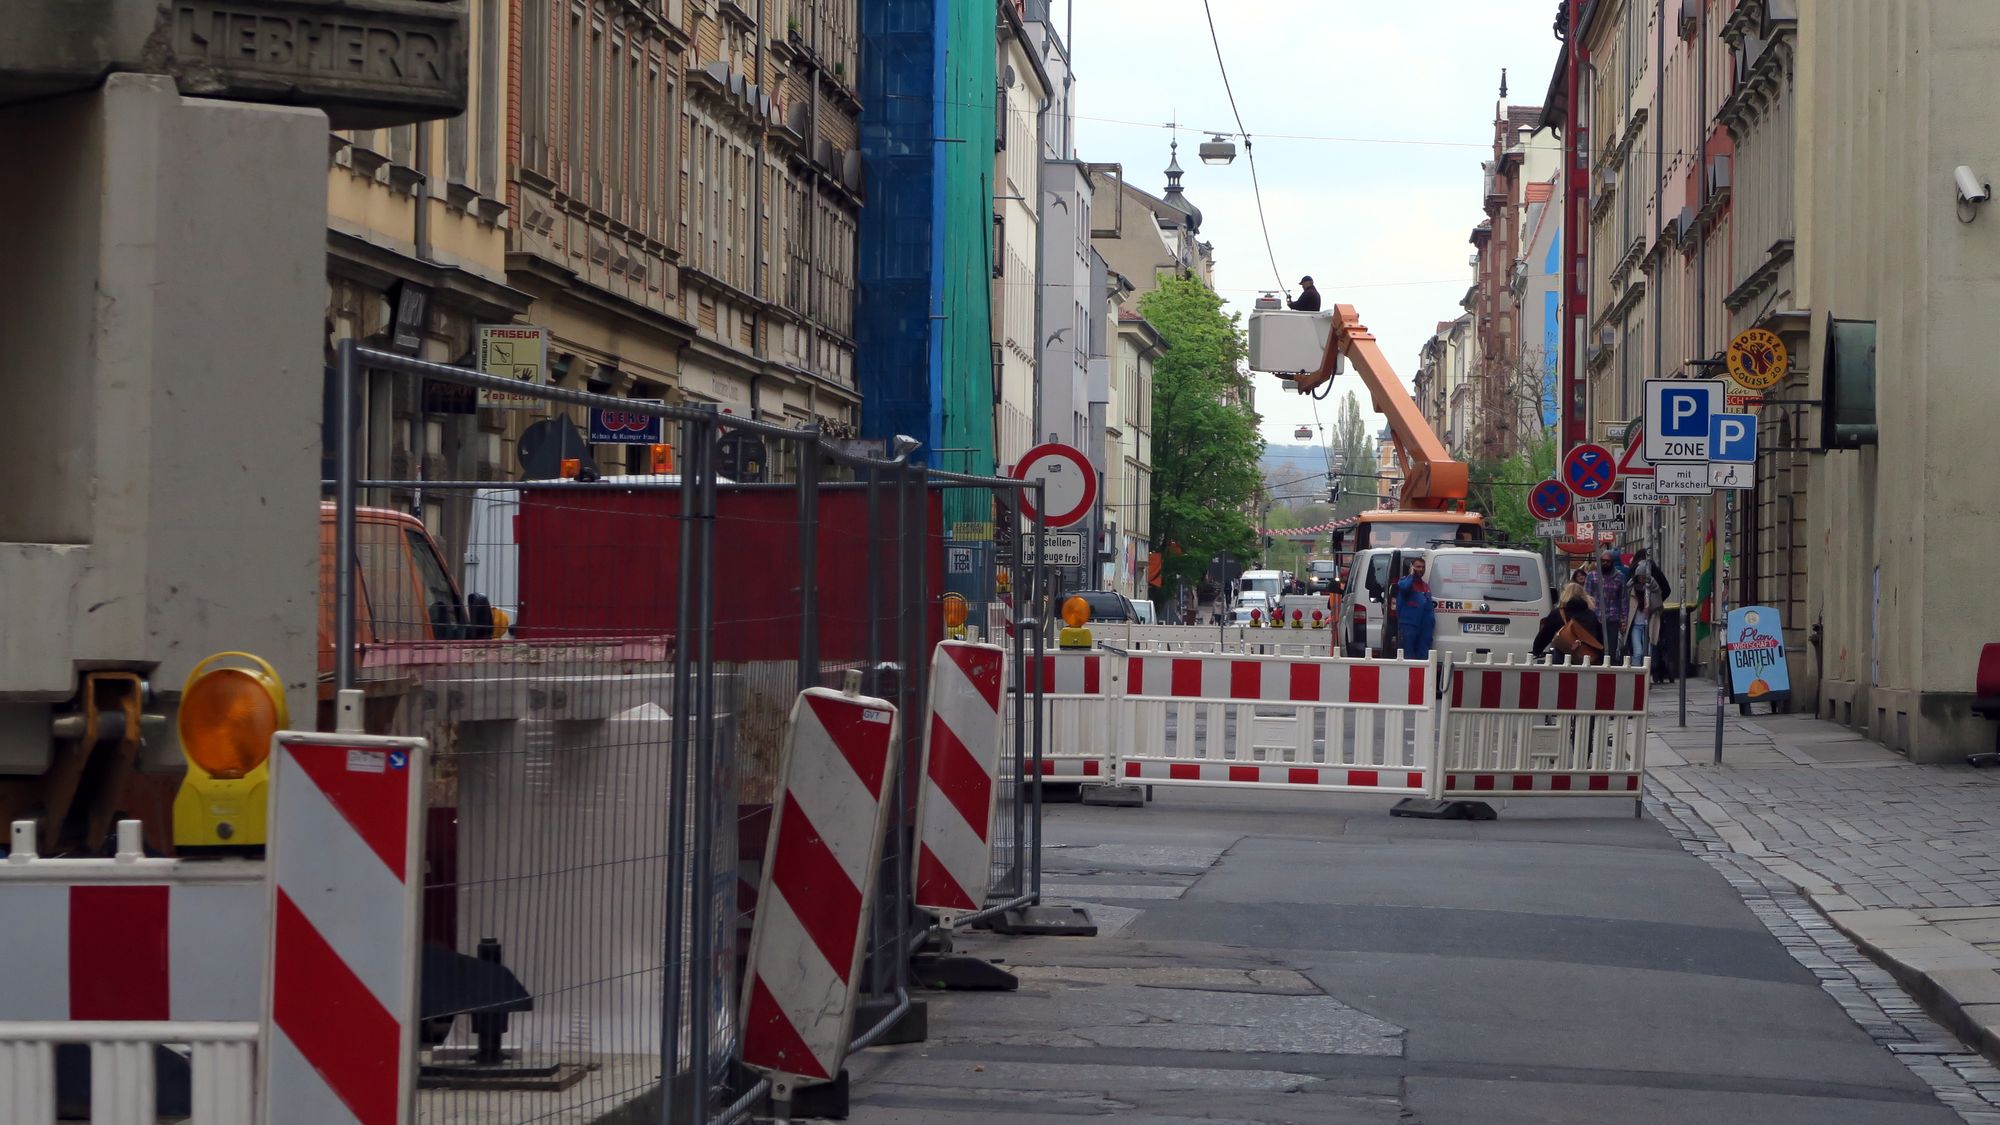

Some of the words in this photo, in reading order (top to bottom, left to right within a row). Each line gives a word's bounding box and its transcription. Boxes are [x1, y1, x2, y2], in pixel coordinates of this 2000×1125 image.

[176, 7, 440, 82] LIEBHERR
[490, 329, 540, 339] FRISEUR
[1732, 332, 1781, 352] HOSTEL
[1733, 366, 1769, 386] LOUISE
[1770, 366, 1781, 379] 20
[1672, 395, 1697, 430] P
[1610, 429, 1625, 437] CAF
[1720, 420, 1745, 455] P
[1665, 443, 1705, 456] ZONE
[1677, 470, 1691, 479] mit
[1632, 481, 1655, 490] Straß
[1029, 537, 1077, 547] Bstellen-
[954, 551, 970, 562] TOI
[1023, 551, 1064, 563] faheuge
[1064, 553, 1079, 563] frei
[954, 563, 970, 571] TOI
[1468, 623, 1481, 631] PIR
[1486, 624, 1494, 632] DE
[1495, 624, 1504, 632] 88
[1740, 627, 1774, 642] Plan
[1735, 648, 1775, 668] GARTEN
